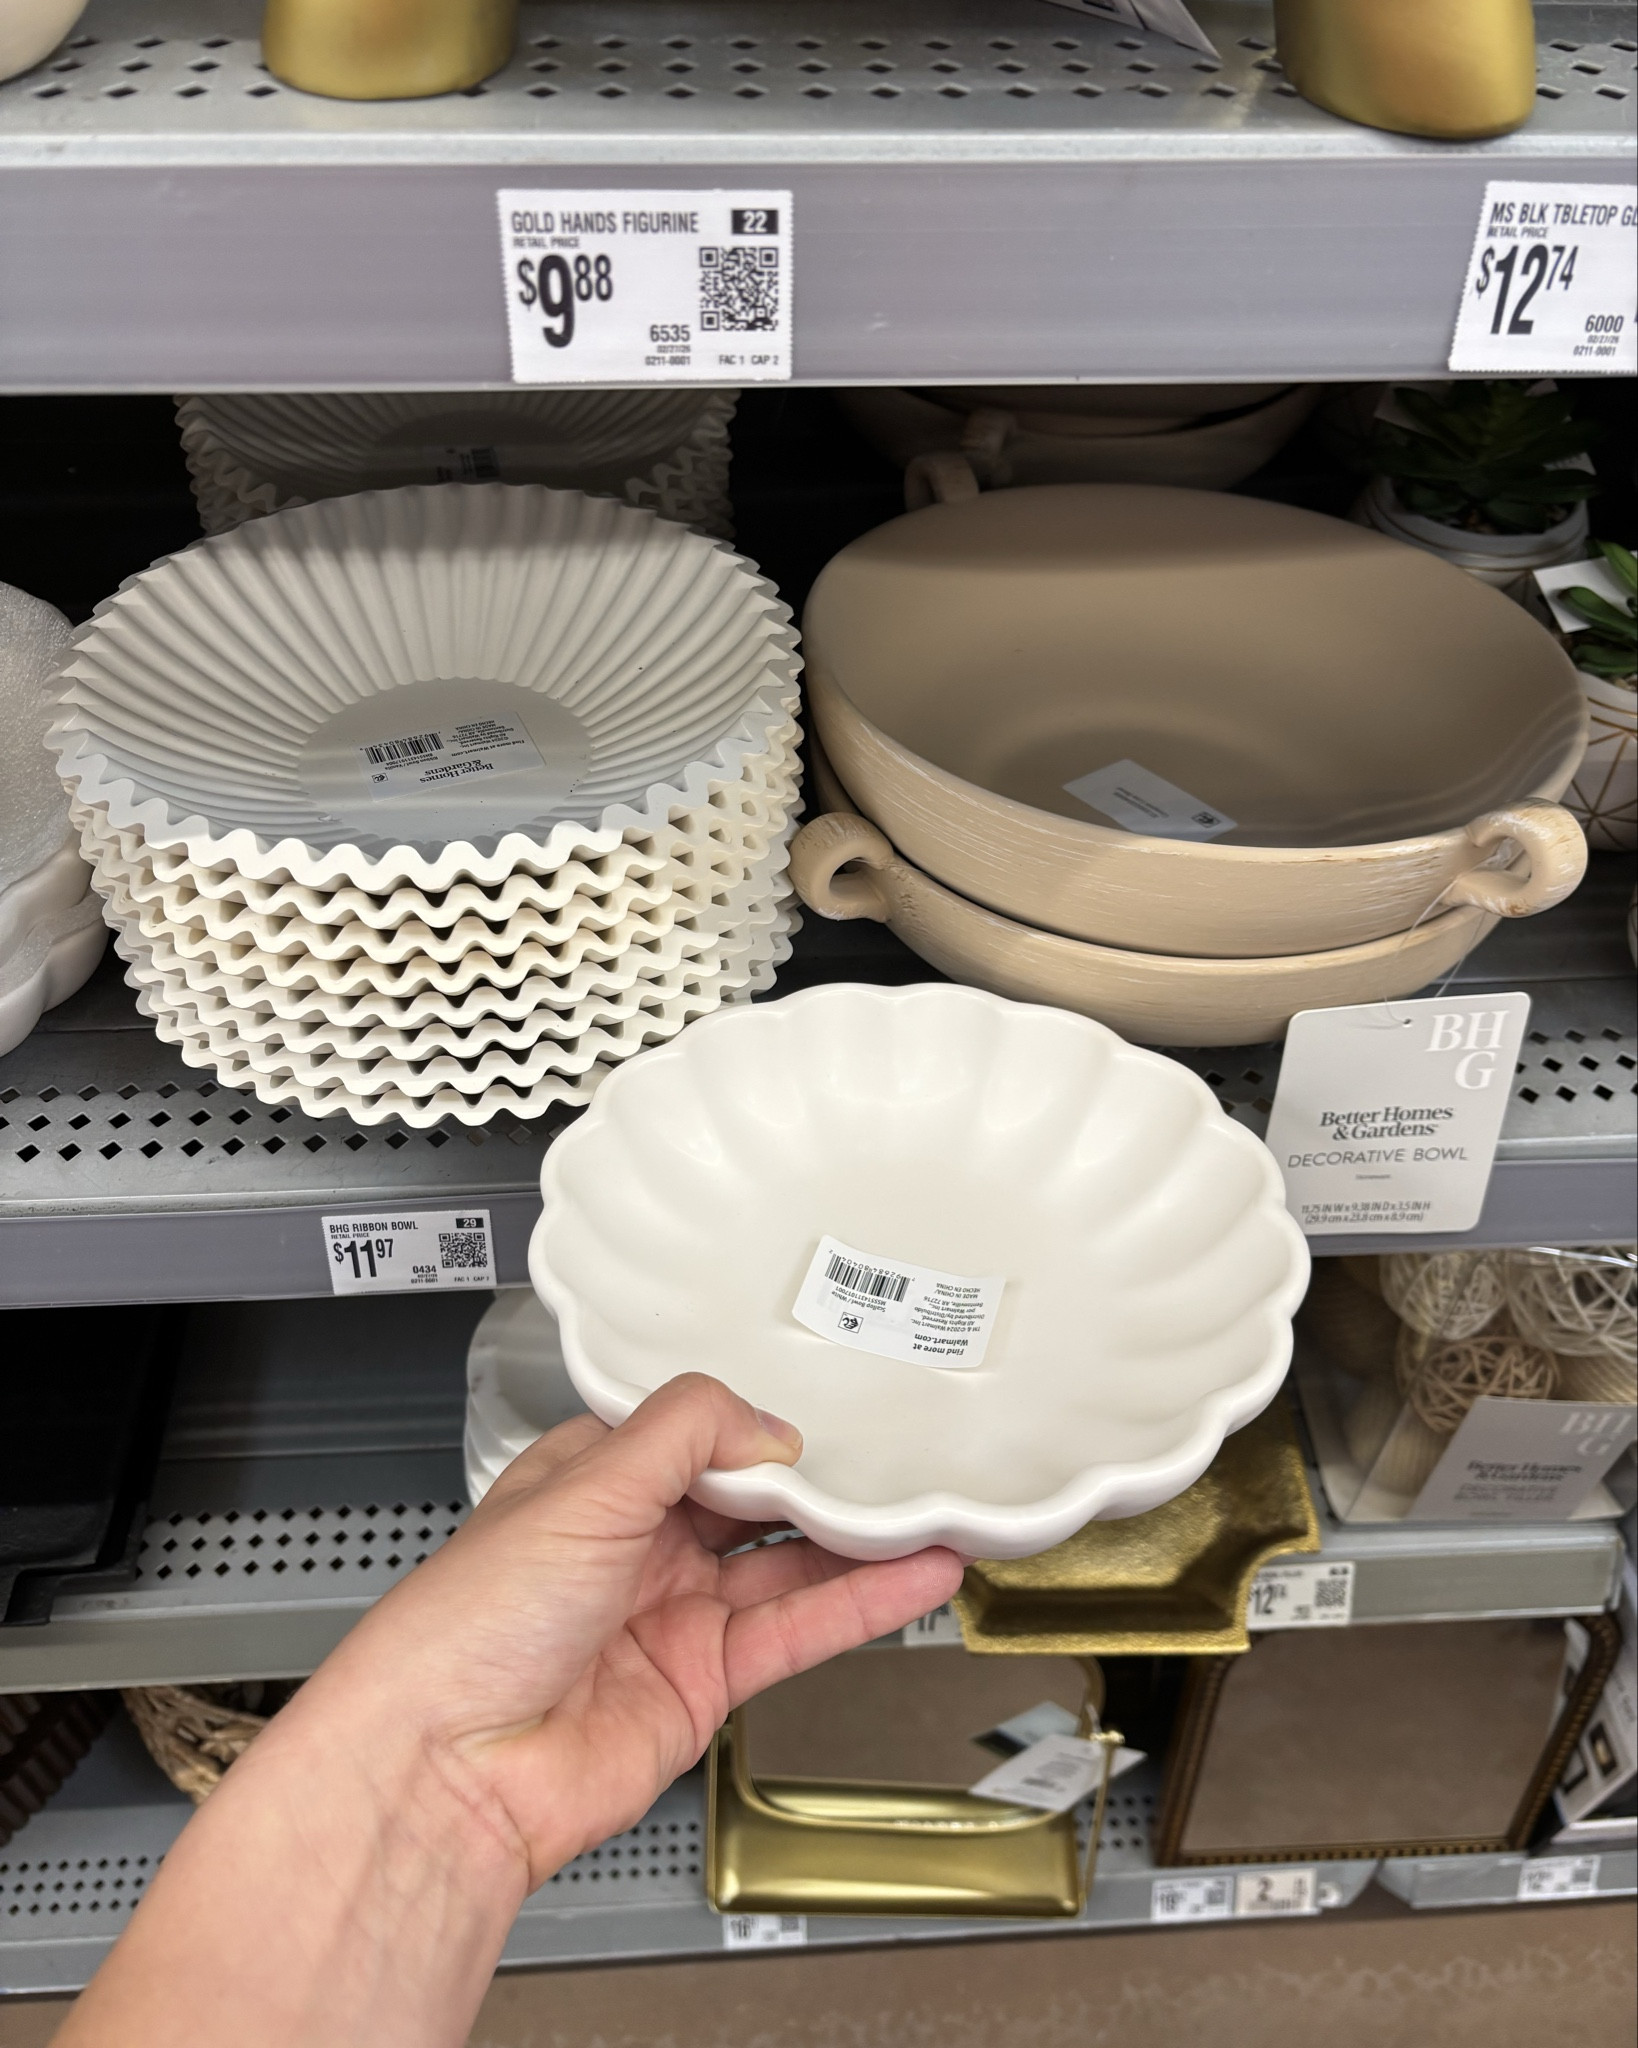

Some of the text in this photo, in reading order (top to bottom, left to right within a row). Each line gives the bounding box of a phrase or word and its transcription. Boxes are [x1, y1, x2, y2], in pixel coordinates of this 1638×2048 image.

[1490, 202, 1515, 224] MS
[1519, 203, 1550, 225] BLK
[1553, 204, 1618, 226] TBLETOP
[512, 211, 699, 234] GOLD HANDS FIGURINE
[743, 210, 768, 233] 22
[1486, 226, 1550, 239] RETAIL PRICE
[513, 236, 580, 249] RETAIL PRICE
[1585, 314, 1625, 333] 6000
[650, 324, 691, 342] 6535
[719, 355, 736, 365] FAC
[751, 355, 769, 365] CAP
[773, 355, 779, 365] 2
[420, 763, 494, 784] Better Homes
[1455, 1051, 1496, 1090] G
[1319, 1105, 1454, 1127] Better Homes
[1287, 1147, 1468, 1169] DECORATIVE BOWL
[329, 1220, 419, 1234] BHG RIBBON BOWL
[463, 1218, 477, 1228] 29
[412, 1265, 437, 1274] 0434
[936, 1282, 954, 1290] CHINA
[831, 1290, 848, 1302] White
[923, 1295, 941, 1305] 72716
[850, 1300, 866, 1308] Bowl
[866, 1303, 887, 1313] Scallop
[922, 1315, 949, 1325] Reserved.
[922, 1321, 946, 1331] Walmart
[914, 1333, 969, 1346] Walmart.com
[913, 1342, 965, 1356] Find more at
